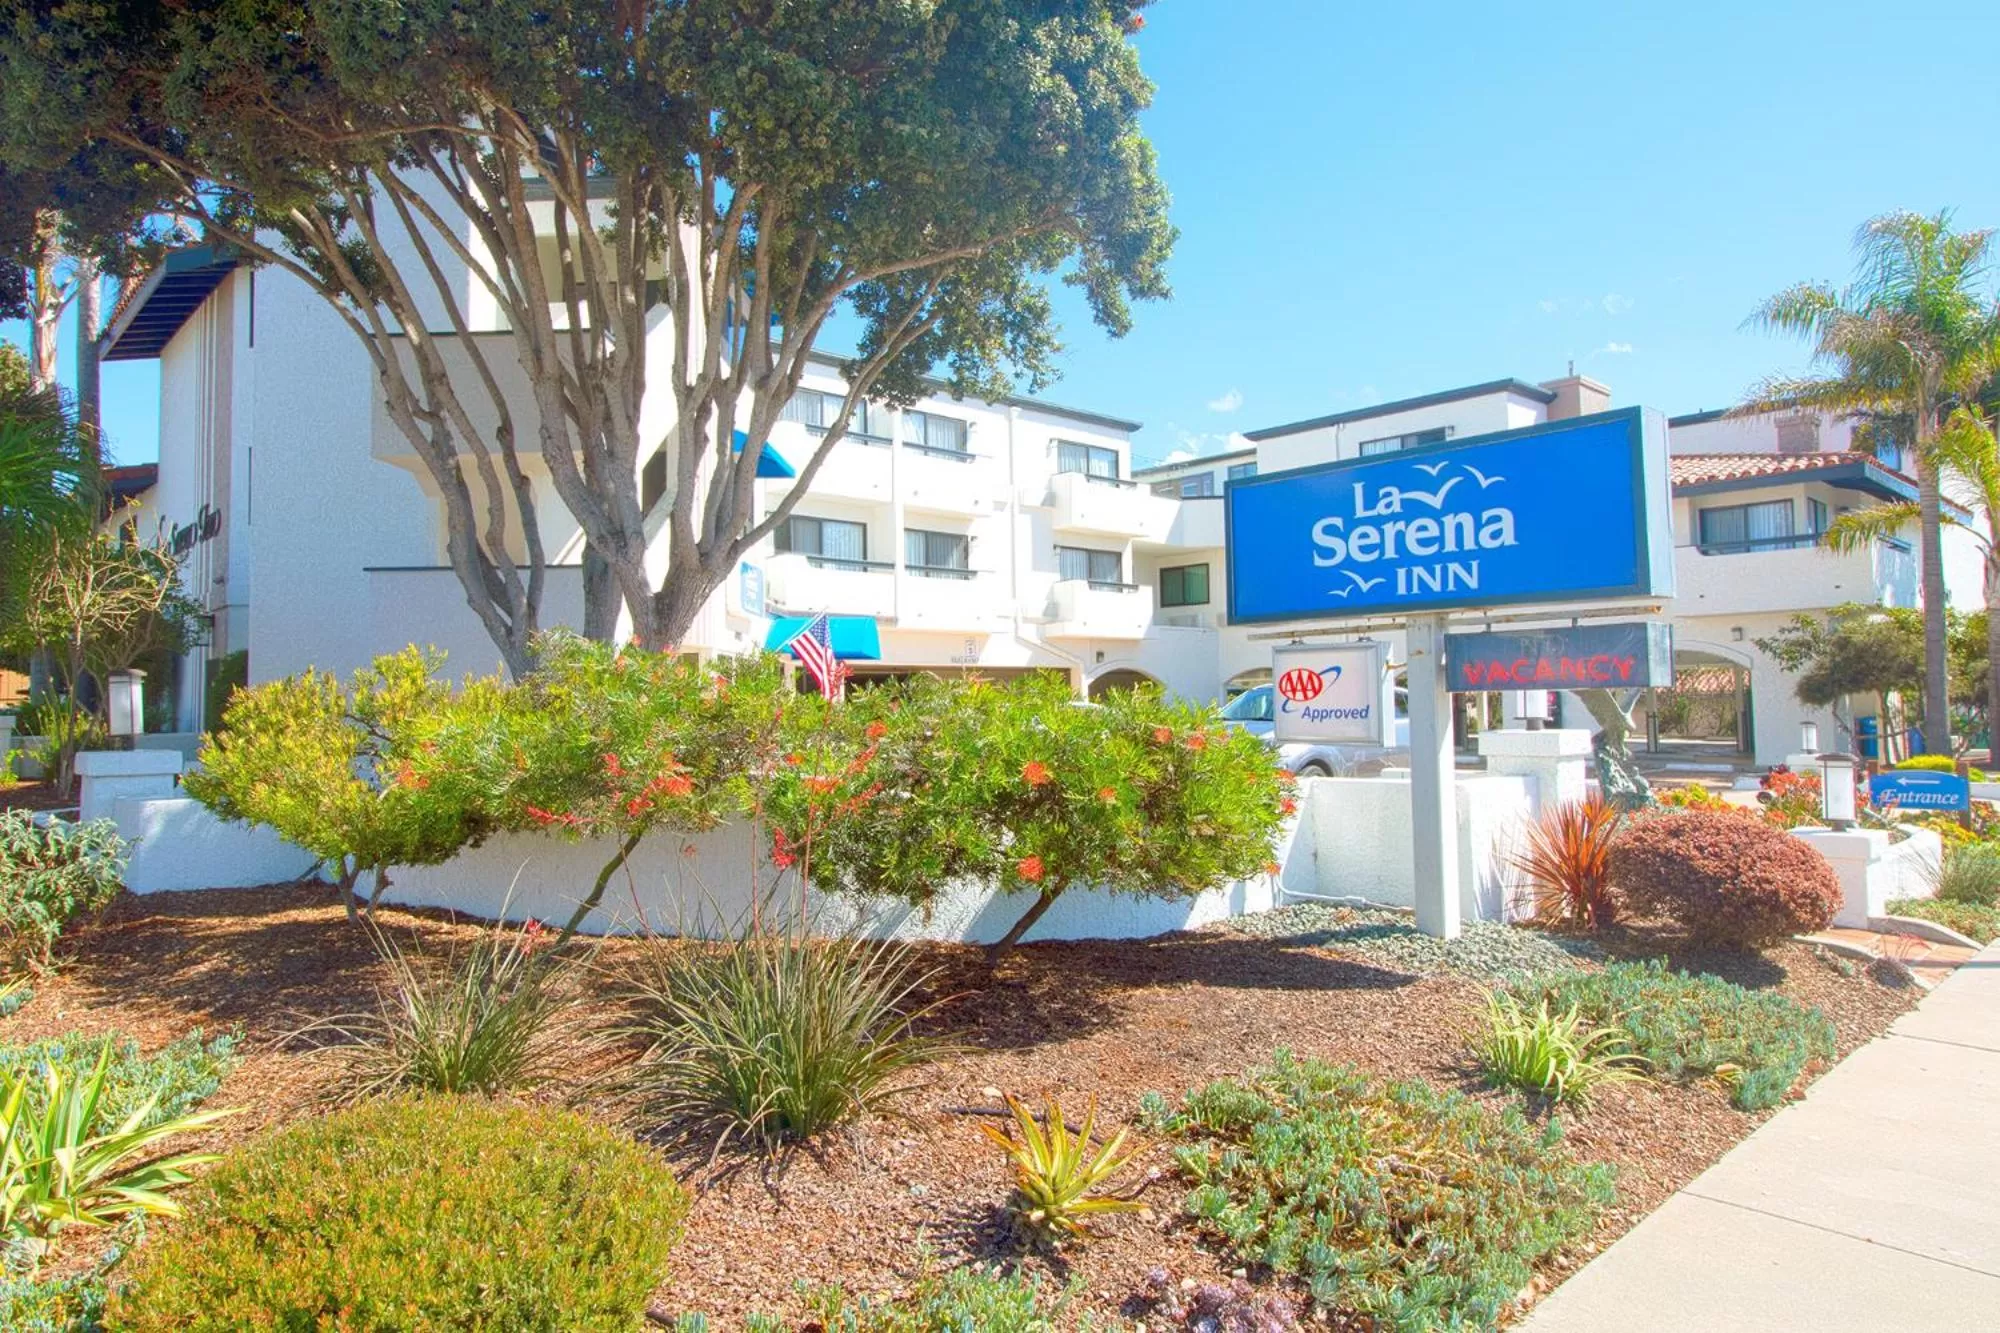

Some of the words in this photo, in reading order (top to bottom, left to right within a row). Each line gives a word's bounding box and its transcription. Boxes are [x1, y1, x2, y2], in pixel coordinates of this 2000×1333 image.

[1353, 482, 1403, 518] La
[1311, 507, 1519, 567] Serena
[1395, 560, 1480, 595] INN
[1281, 668, 1321, 701] AAA
[1463, 655, 1636, 685] VACANCY
[1301, 704, 1369, 722] Approved
[1880, 788, 1959, 806] Entrance
